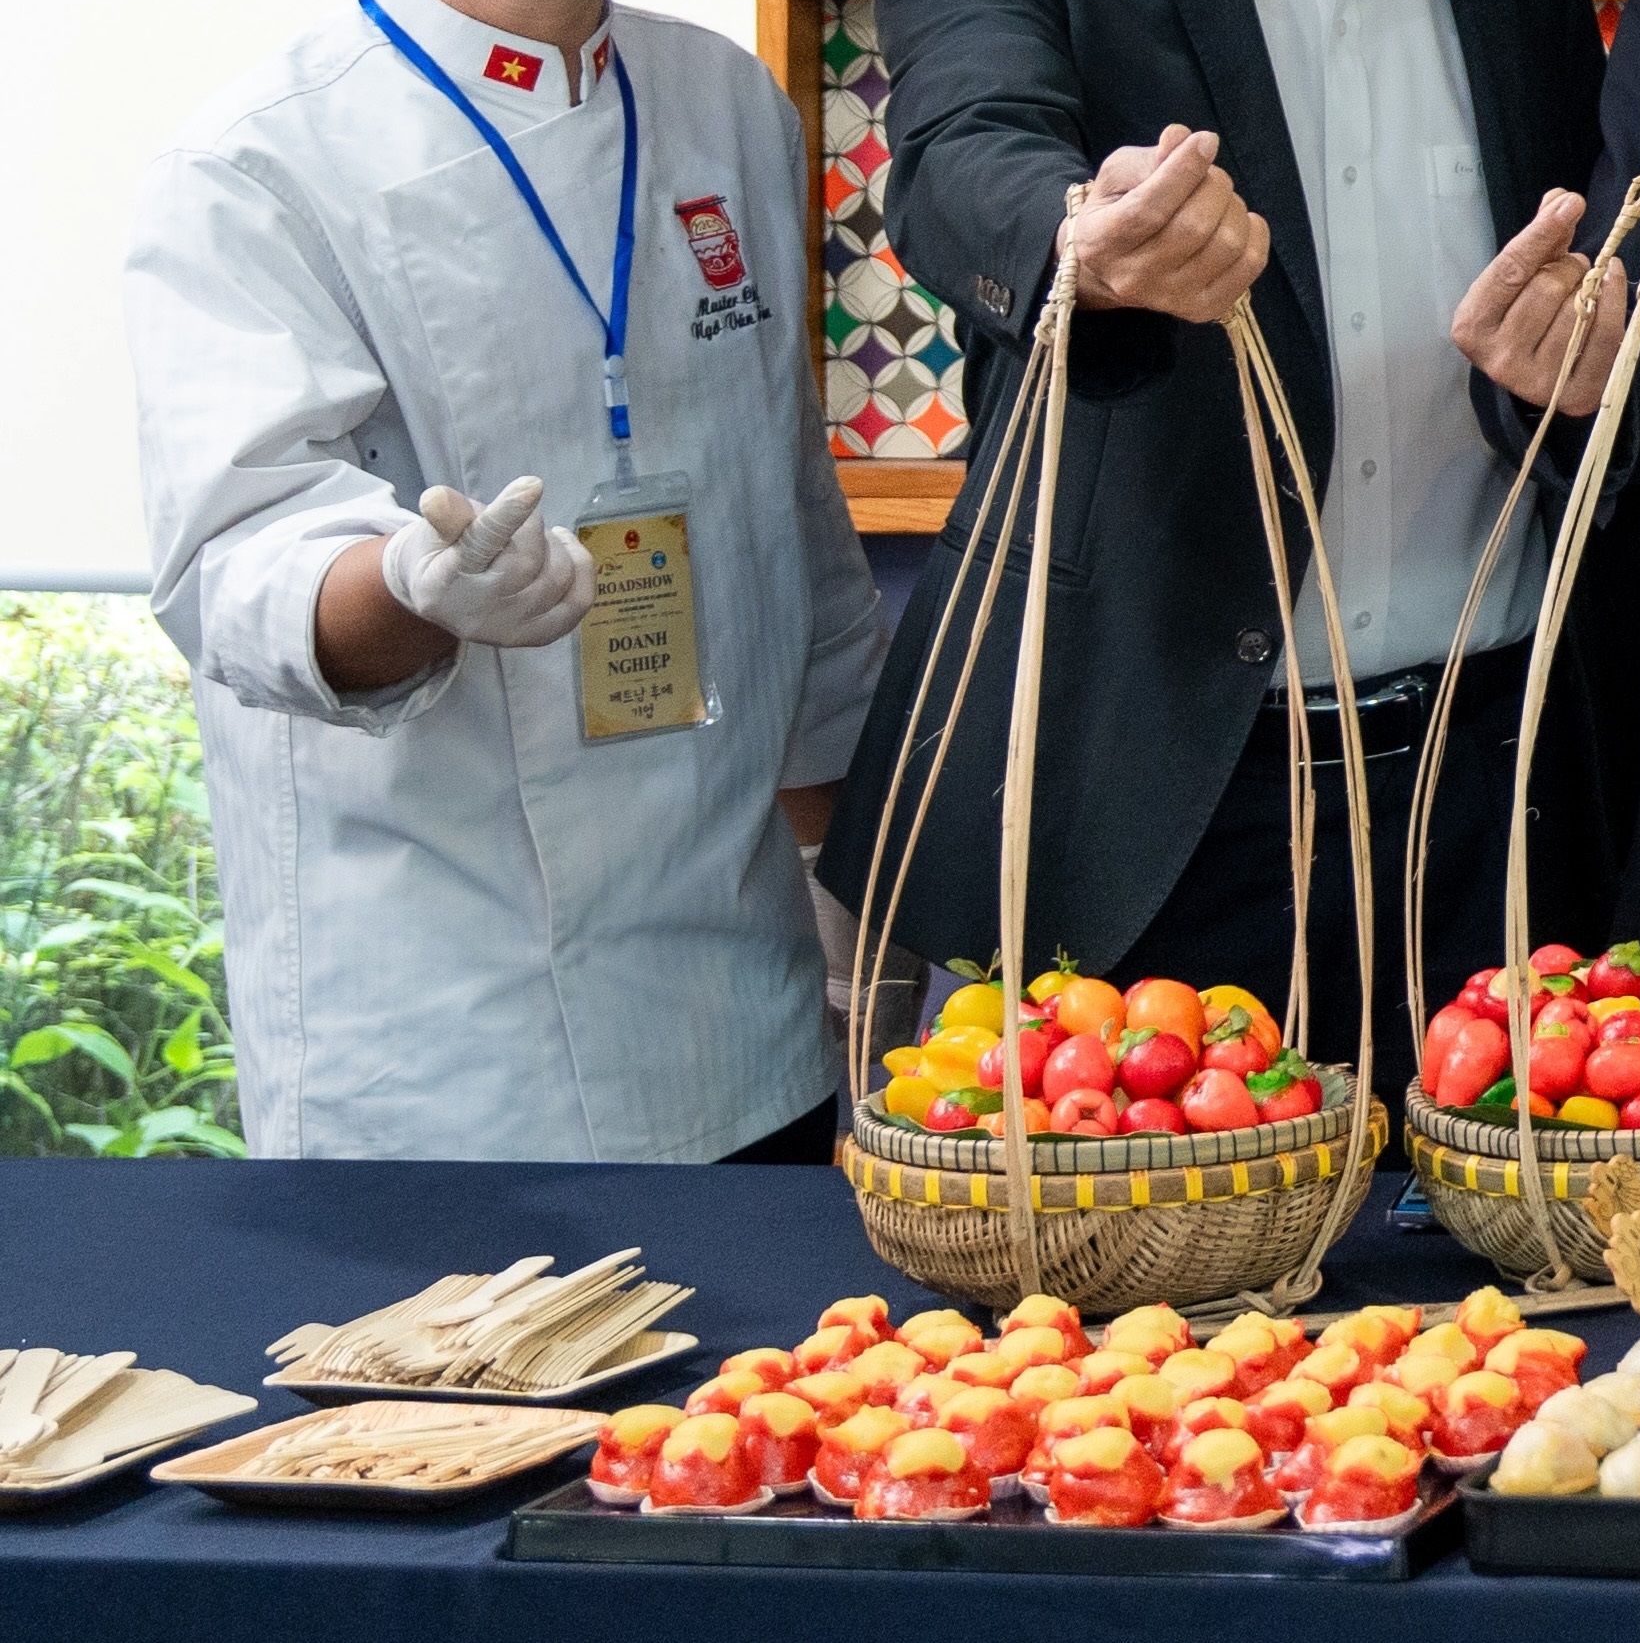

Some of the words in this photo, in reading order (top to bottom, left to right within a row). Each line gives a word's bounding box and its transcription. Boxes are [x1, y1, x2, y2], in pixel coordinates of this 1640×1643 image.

[597, 573, 674, 596] ROADSHOW
[608, 630, 668, 653] DOANH
[608, 653, 671, 676] NGHIỆP
